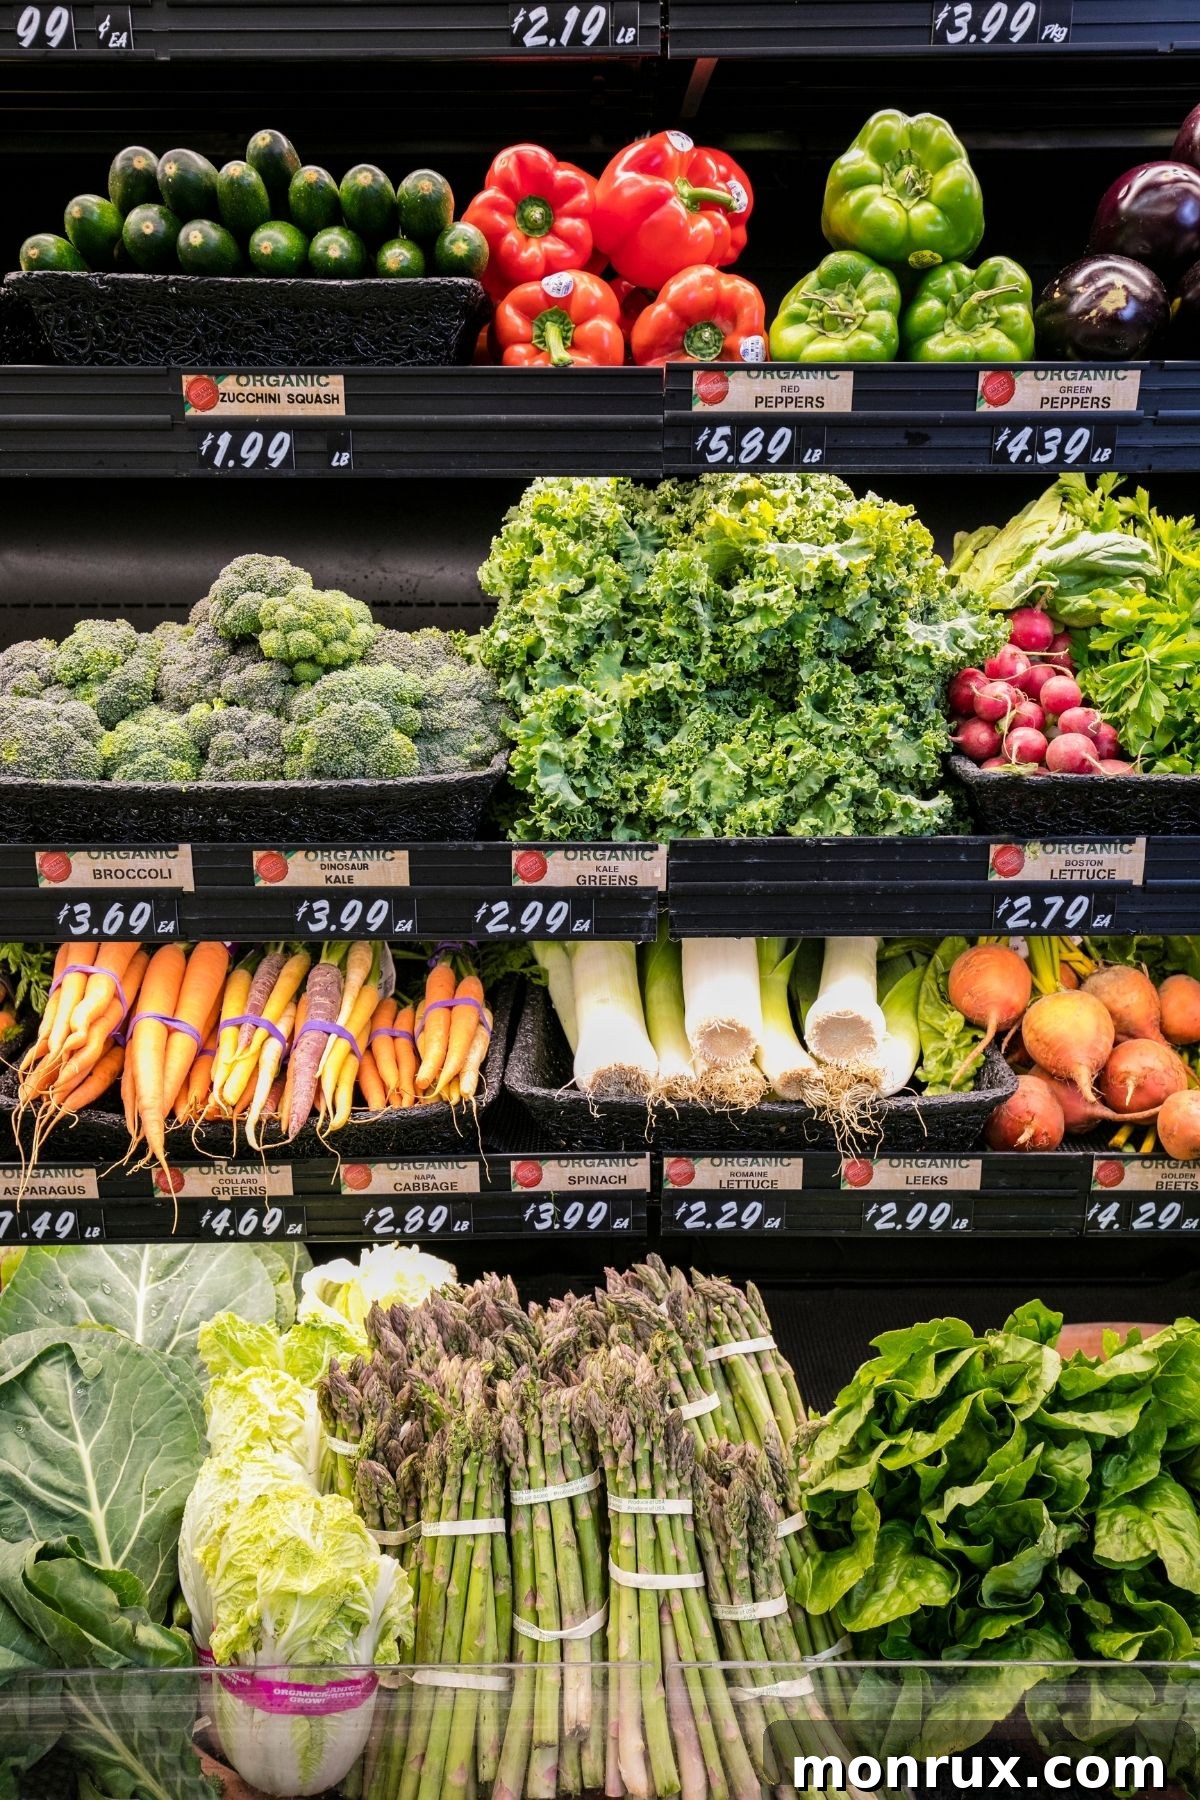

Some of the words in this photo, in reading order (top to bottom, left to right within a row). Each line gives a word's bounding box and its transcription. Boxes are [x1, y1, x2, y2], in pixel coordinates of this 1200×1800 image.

[17, 5, 69, 48] 99
[108, 32, 127, 48] EA
[511, 5, 606, 47] $2.19
[615, 26, 636, 44] LB
[935, 1, 1036, 43] $3.99
[1041, 23, 1068, 43] Pkg
[747, 370, 840, 380] ORGANIC
[1033, 370, 1128, 381] ORGANIC
[235, 375, 330, 387] ORGANIC
[780, 385, 800, 393] RED
[1059, 386, 1092, 394] GREEN
[219, 392, 281, 403] ZUCCHINI
[287, 393, 340, 404] SQUASH
[754, 396, 825, 408] PEPPERS
[1040, 396, 1111, 409] PEPPERS
[200, 431, 291, 468] $1.99
[331, 451, 350, 466] LB
[695, 425, 793, 464] $5.89
[803, 448, 822, 463] LB
[994, 426, 1091, 464] $4.39
[1092, 447, 1112, 463] LB
[1042, 843, 1133, 854] ORGANIC
[87, 850, 178, 860] ORGANIC
[304, 850, 396, 862] ORGANIC
[563, 850, 654, 861] ORGANIC
[320, 863, 369, 871] DINOSAUR
[1064, 859, 1104, 867] BOSTON
[93, 868, 172, 879] BROCCOLI
[595, 865, 619, 873] KALE
[1050, 869, 1116, 880] LETTUCE
[324, 875, 354, 884] KALE
[576, 874, 638, 886] GREENS
[296, 899, 389, 933] $3.99
[394, 919, 413, 932] EA
[474, 900, 569, 933] $2.99
[572, 919, 591, 932] EA
[995, 895, 1090, 929] $2.79
[1092, 914, 1112, 928] EA
[56, 901, 151, 935] $3.69
[157, 920, 175, 934] EA
[387, 1162, 467, 1170] ORGANIC
[557, 1158, 639, 1168] ORGANIC
[710, 1158, 791, 1167] ORGANIC
[888, 1159, 970, 1169] ORGANIC
[568, 1175, 627, 1186] SPINACH
[719, 1180, 779, 1189] LETTUCE
[905, 1176, 948, 1185] LEEKS
[1156, 1181, 1199, 1190] BEETS
[211, 1186, 267, 1196] GREENS
[393, 1182, 458, 1192] CABBAGE
[363, 1205, 448, 1234] $2.89
[453, 1220, 470, 1232] LB
[523, 1201, 608, 1231] $3.99
[613, 1217, 630, 1229] EA
[675, 1201, 763, 1229] $2.29
[764, 1217, 782, 1229] EA
[864, 1202, 951, 1231] $2.99
[951, 1218, 969, 1230] LB
[1087, 1202, 1181, 1230] $4.29
[1181, 1218, 1200, 1230] EA
[200, 1207, 283, 1236] $4.69
[286, 1223, 303, 1235] EA
[84, 1226, 100, 1238] LB
